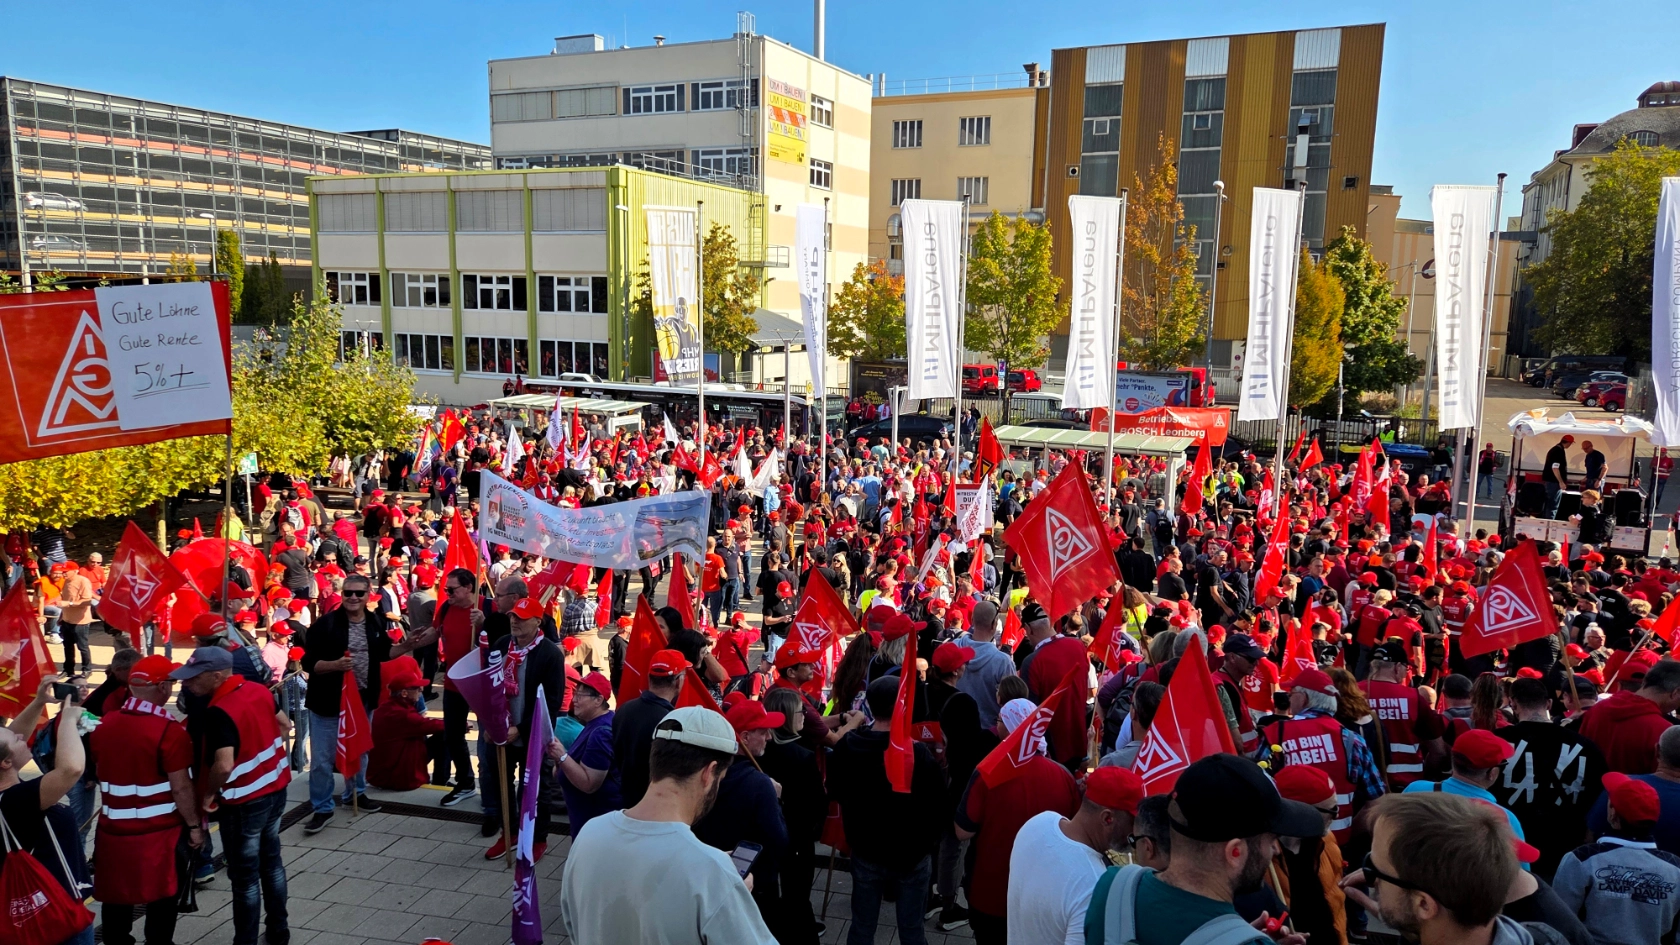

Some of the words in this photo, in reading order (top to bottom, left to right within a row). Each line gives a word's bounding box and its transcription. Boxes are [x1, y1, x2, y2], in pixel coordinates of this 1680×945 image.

[111, 301, 154, 325] Gute
[159, 302, 200, 318] Löhne
[119, 334, 152, 351] Gute
[158, 332, 202, 347] Rente
[1120, 427, 1158, 437] BOSCH
[1160, 427, 1206, 439] Leonberg
[1378, 699, 1399, 708] BIN
[1282, 739, 1298, 753] CH
[1298, 735, 1321, 749] BIN
